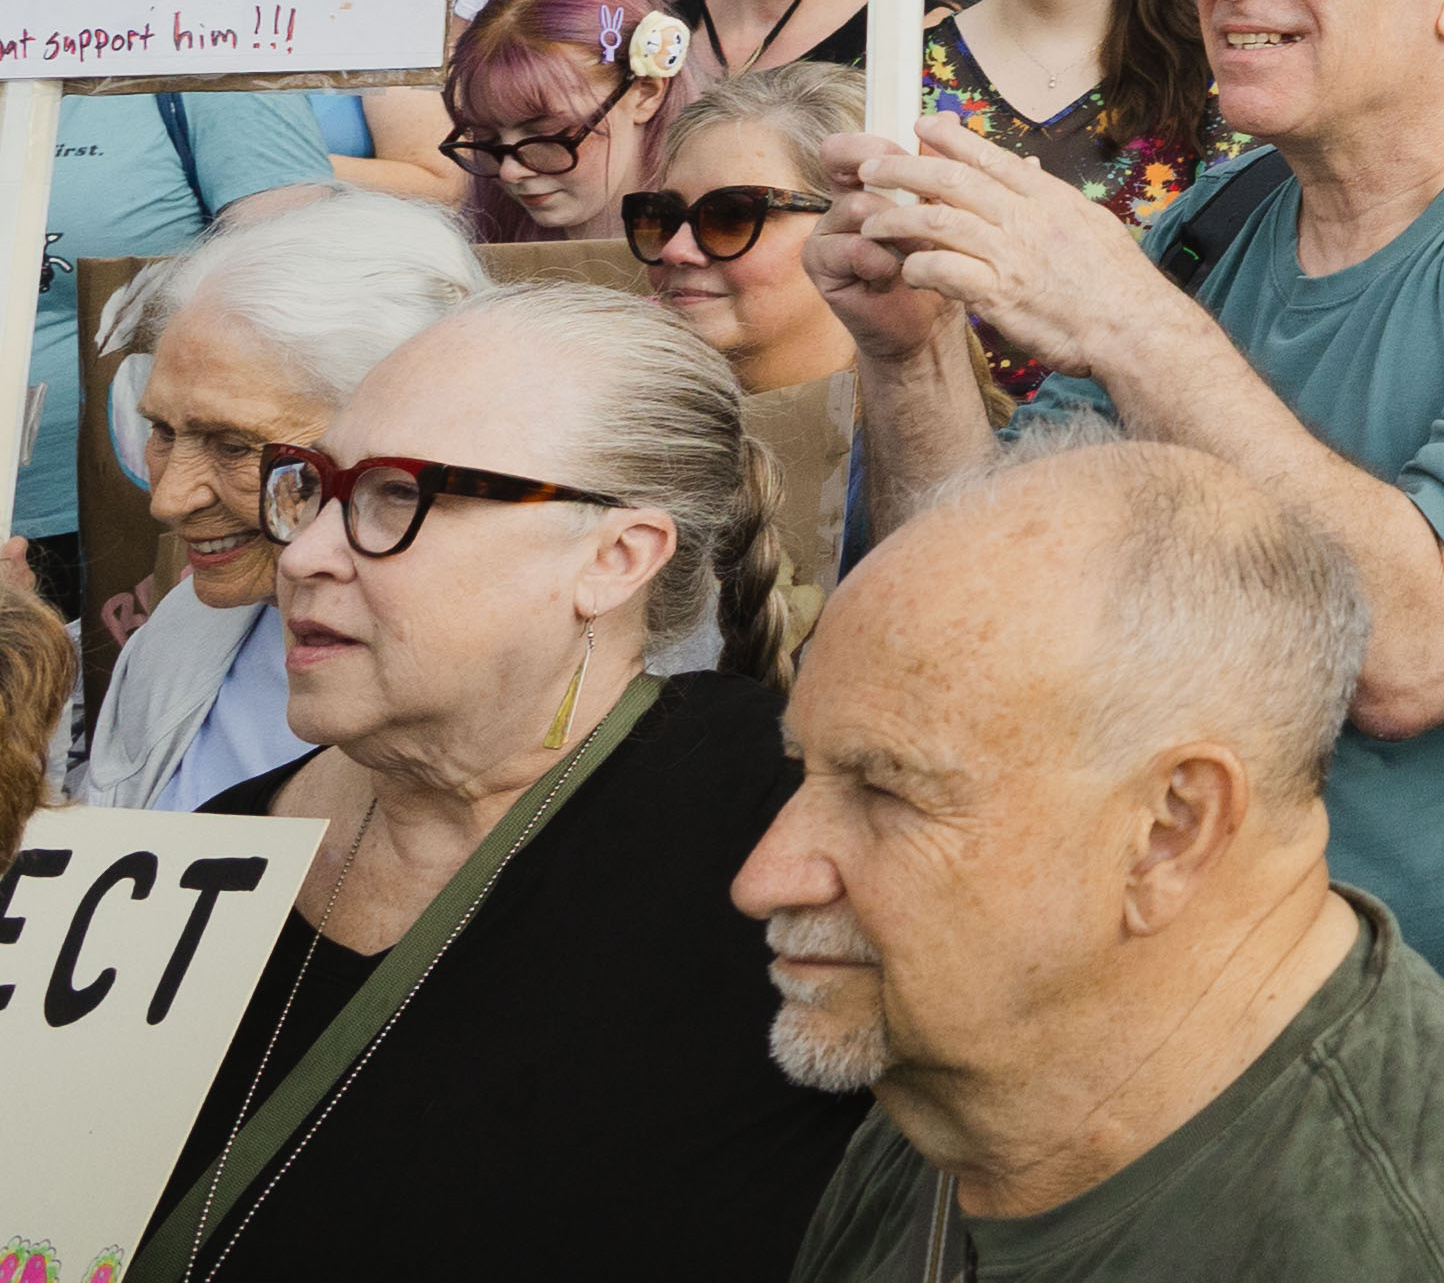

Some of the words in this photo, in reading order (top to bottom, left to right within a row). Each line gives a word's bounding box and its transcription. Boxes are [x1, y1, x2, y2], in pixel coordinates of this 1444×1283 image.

[43, 23, 155, 62] support
[173, 11, 239, 51] him
[56, 144, 104, 157] irst.
